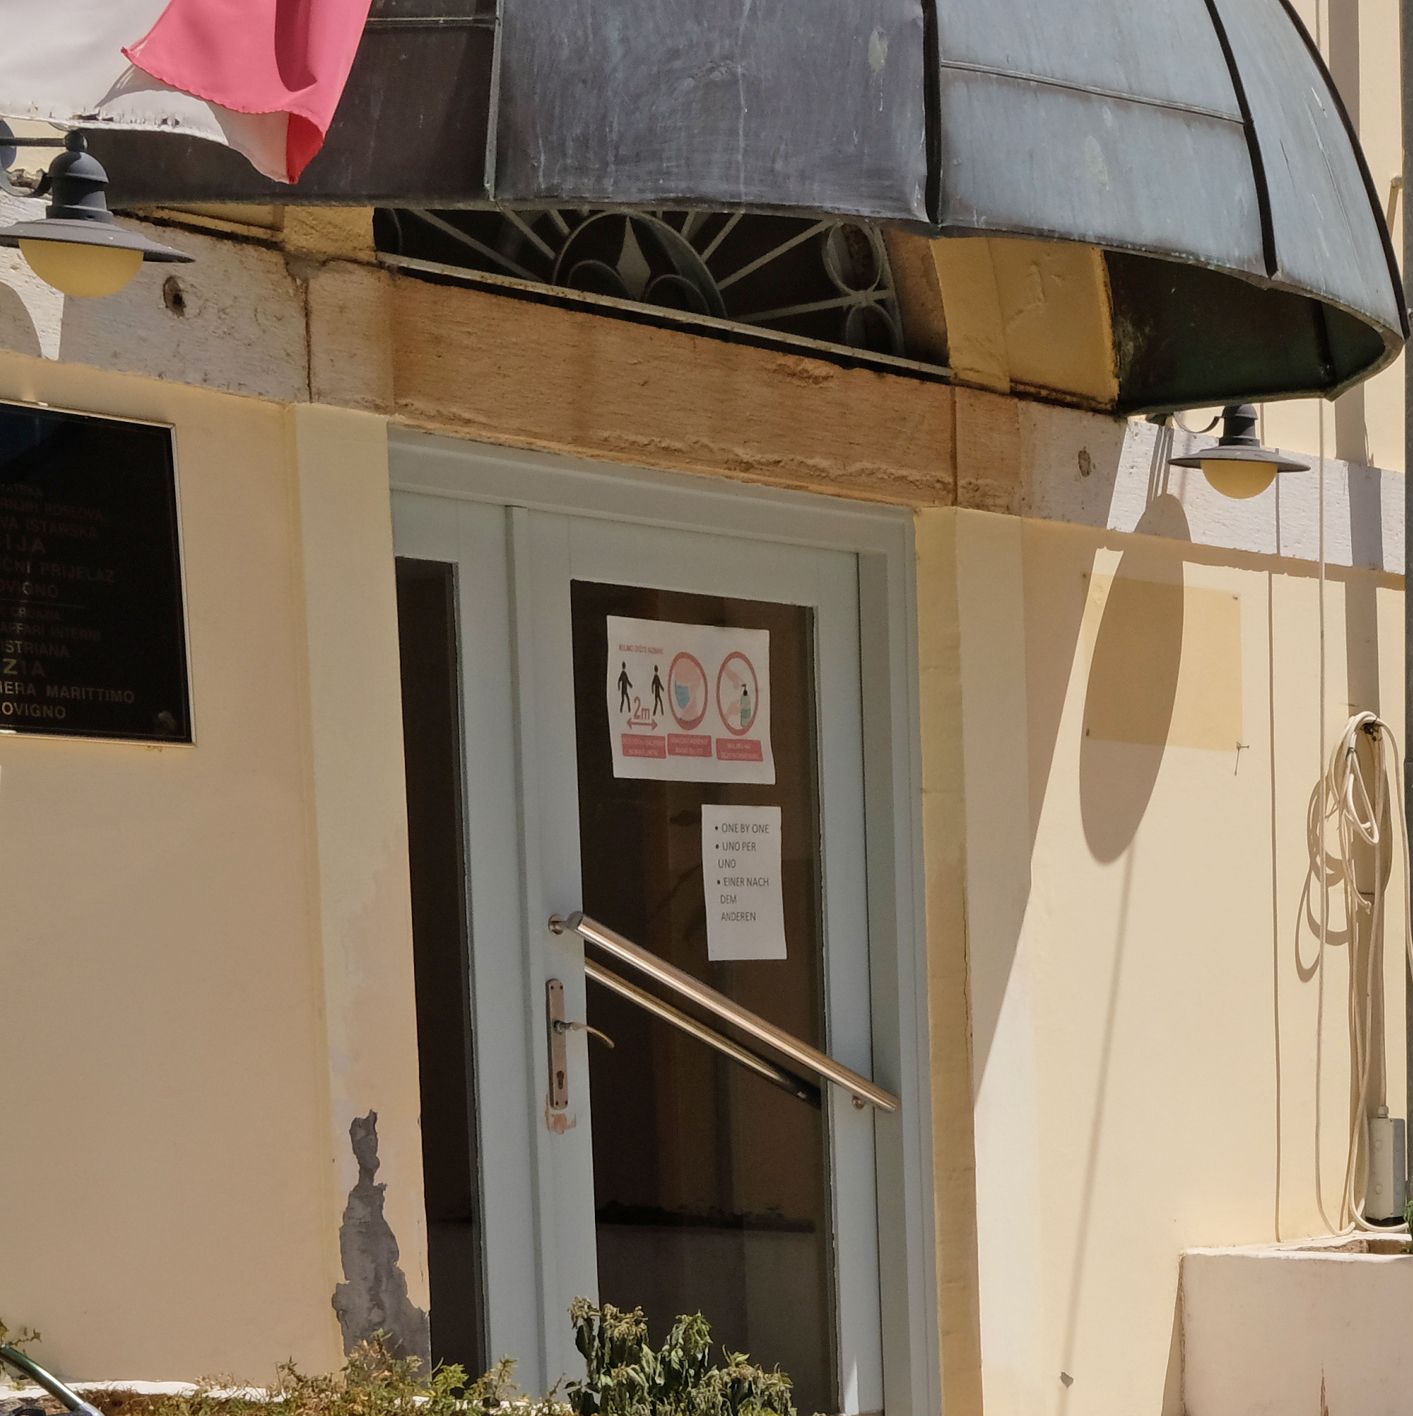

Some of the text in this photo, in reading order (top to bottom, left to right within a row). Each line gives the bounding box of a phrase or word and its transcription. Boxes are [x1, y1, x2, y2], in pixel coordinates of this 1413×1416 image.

[46, 684, 135, 705] MARITTIMO
[721, 823, 769, 833] ONE BY ONE
[722, 842, 756, 851] UNO PER
[718, 859, 736, 868] UNO
[723, 877, 769, 887] EINER NACH
[720, 895, 737, 904] DEM
[721, 912, 757, 921] ANDEREN
